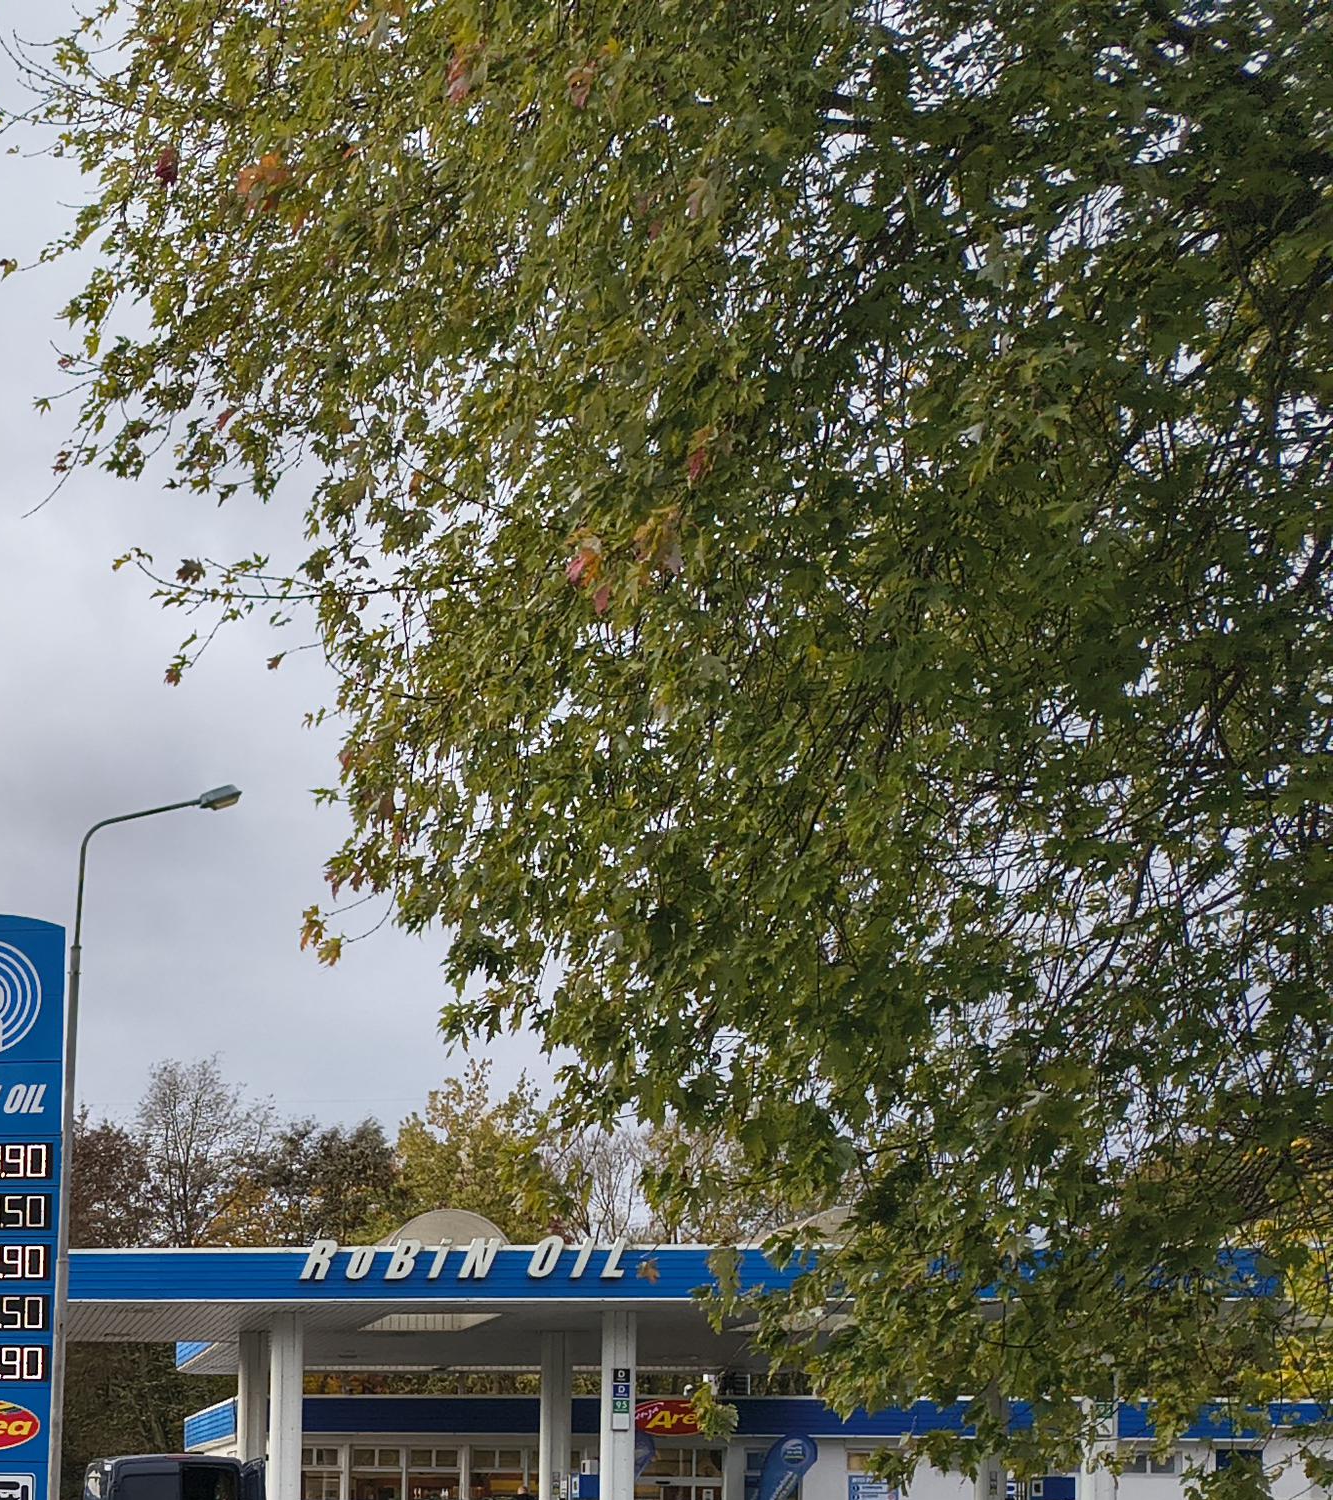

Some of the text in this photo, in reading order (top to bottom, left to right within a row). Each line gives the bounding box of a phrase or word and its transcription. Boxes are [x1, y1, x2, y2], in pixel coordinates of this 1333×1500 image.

[3, 1083, 47, 1115] OIL
[526, 1235, 628, 1279] OIL
[618, 1369, 625, 1378] D
[618, 1385, 625, 1393] D
[615, 1400, 628, 1409] 95
[645, 1410, 697, 1429] Are
